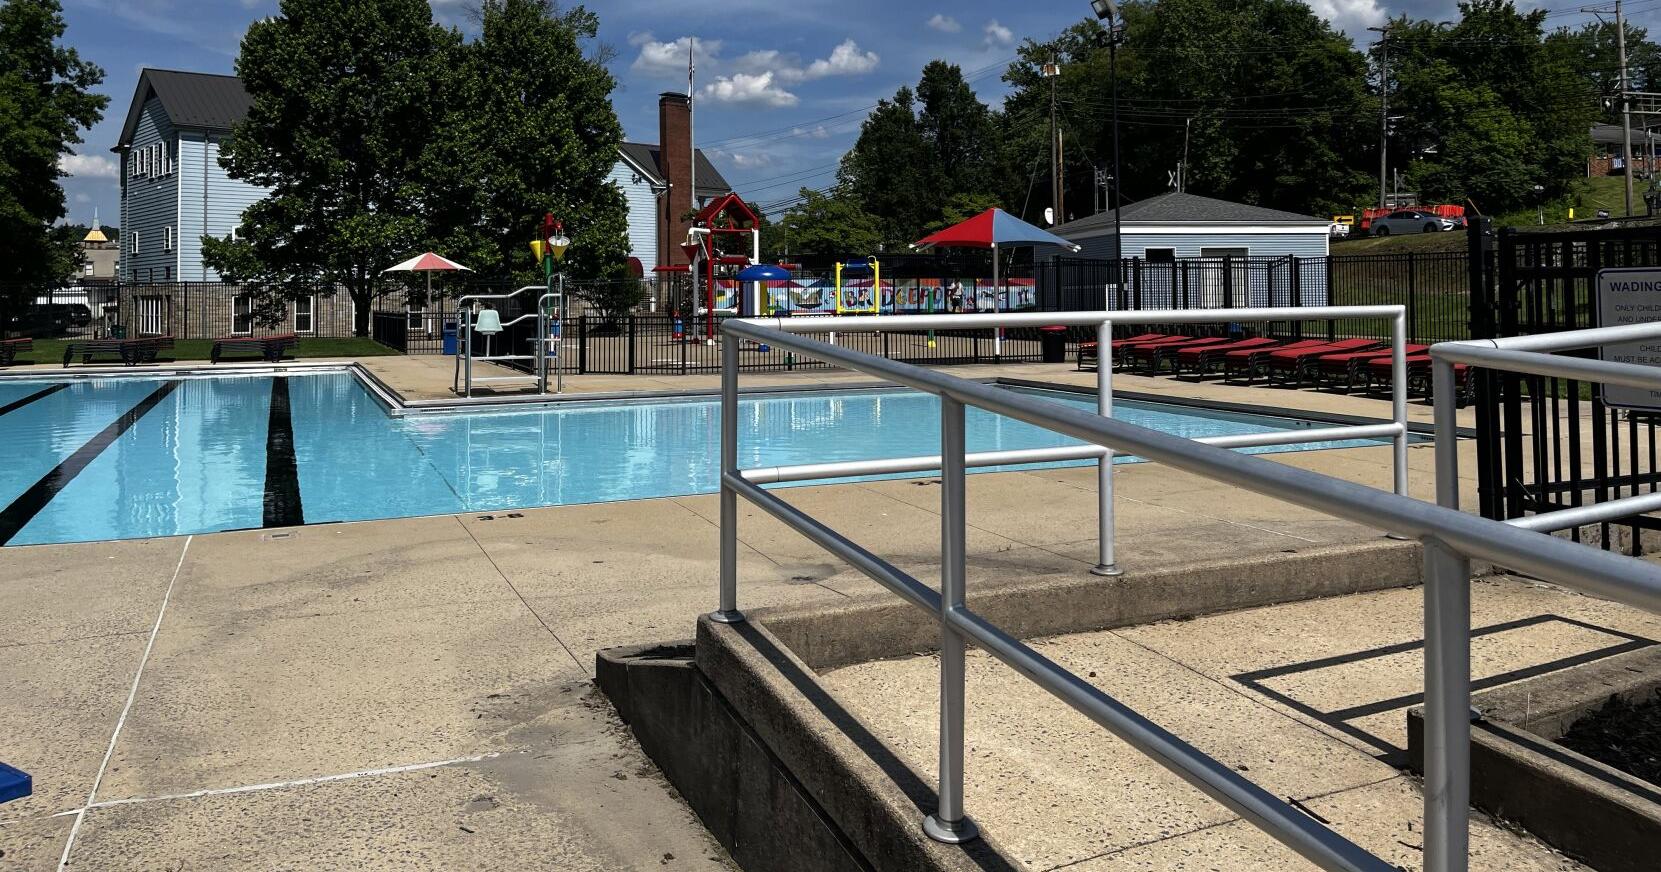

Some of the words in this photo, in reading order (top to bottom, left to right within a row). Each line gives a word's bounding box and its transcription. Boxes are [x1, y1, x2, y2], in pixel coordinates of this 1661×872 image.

[1609, 281, 1661, 292] WADING
[1615, 304, 1634, 312] ONLY
[1617, 315, 1634, 323] AND
[1613, 355, 1635, 363] MUST
[1637, 356, 1648, 364] BE
